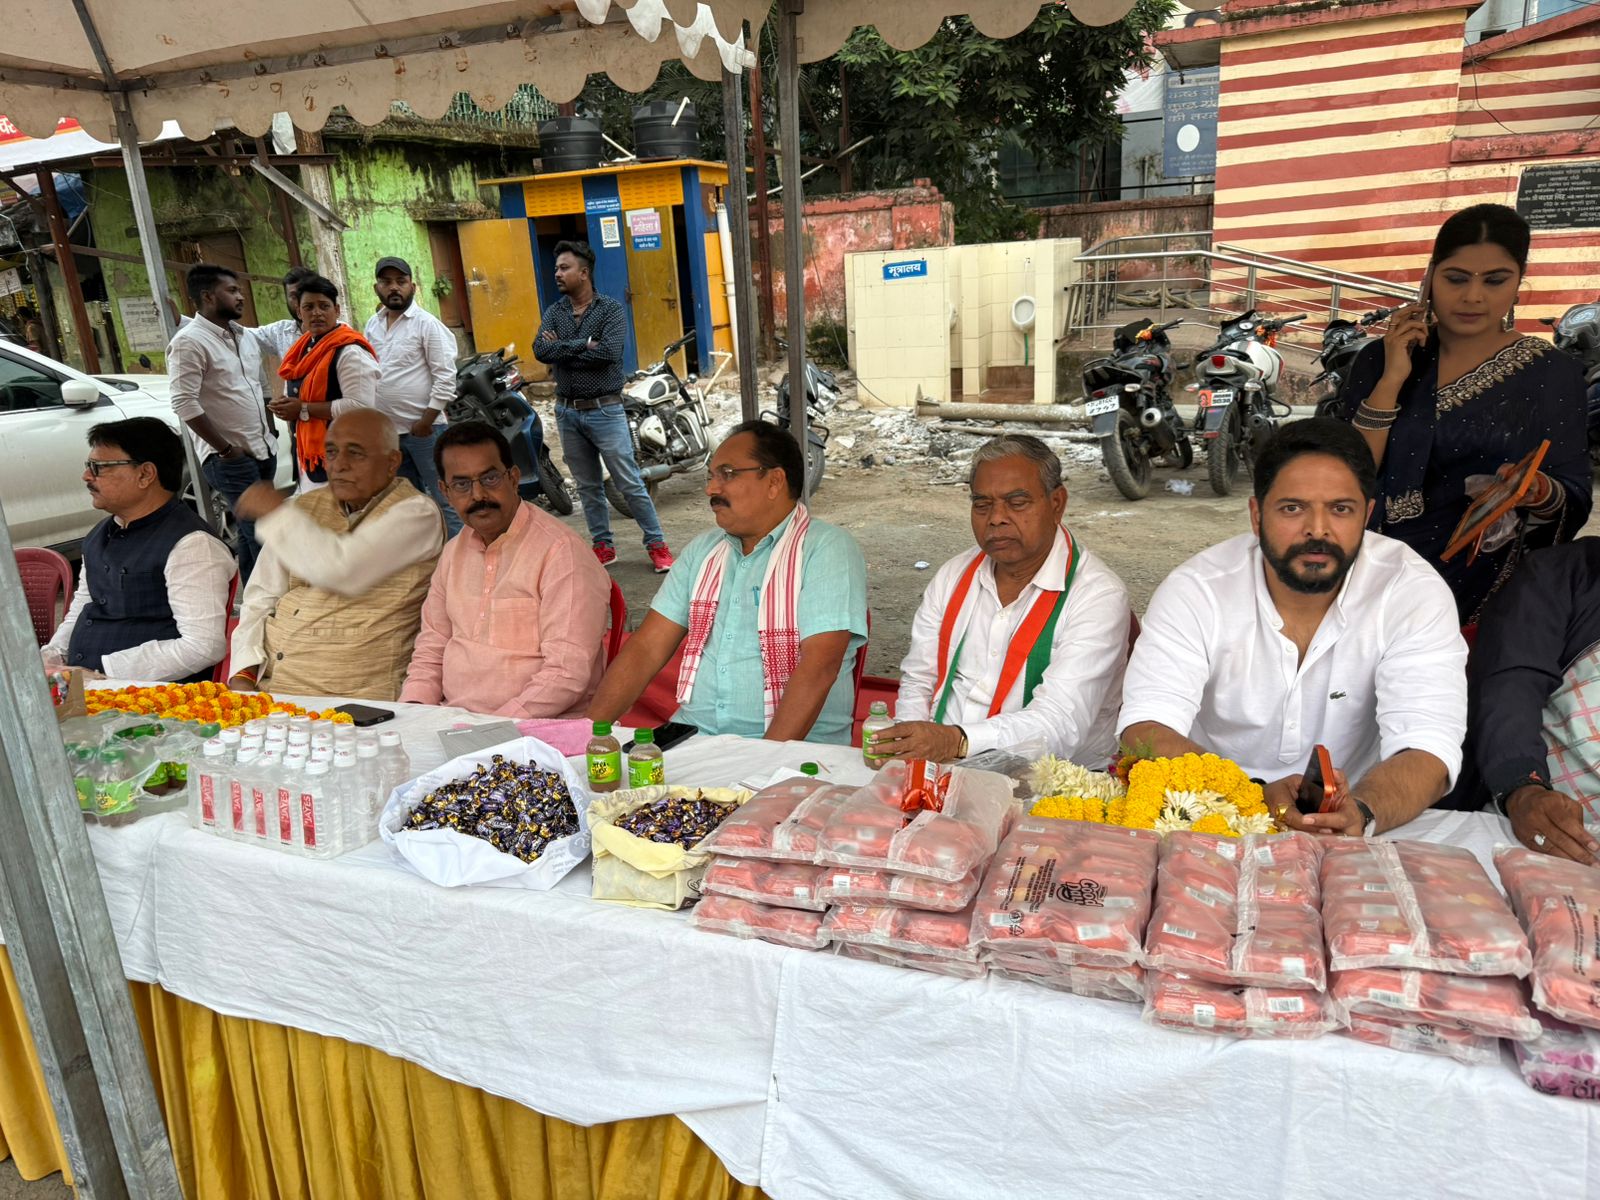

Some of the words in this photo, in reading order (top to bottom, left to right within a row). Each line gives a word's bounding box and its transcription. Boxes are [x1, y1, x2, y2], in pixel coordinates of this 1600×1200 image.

[888, 263, 921, 277] मूत्रालय
[1057, 882, 1084, 905] Day
[1080, 879, 1104, 907] Good
